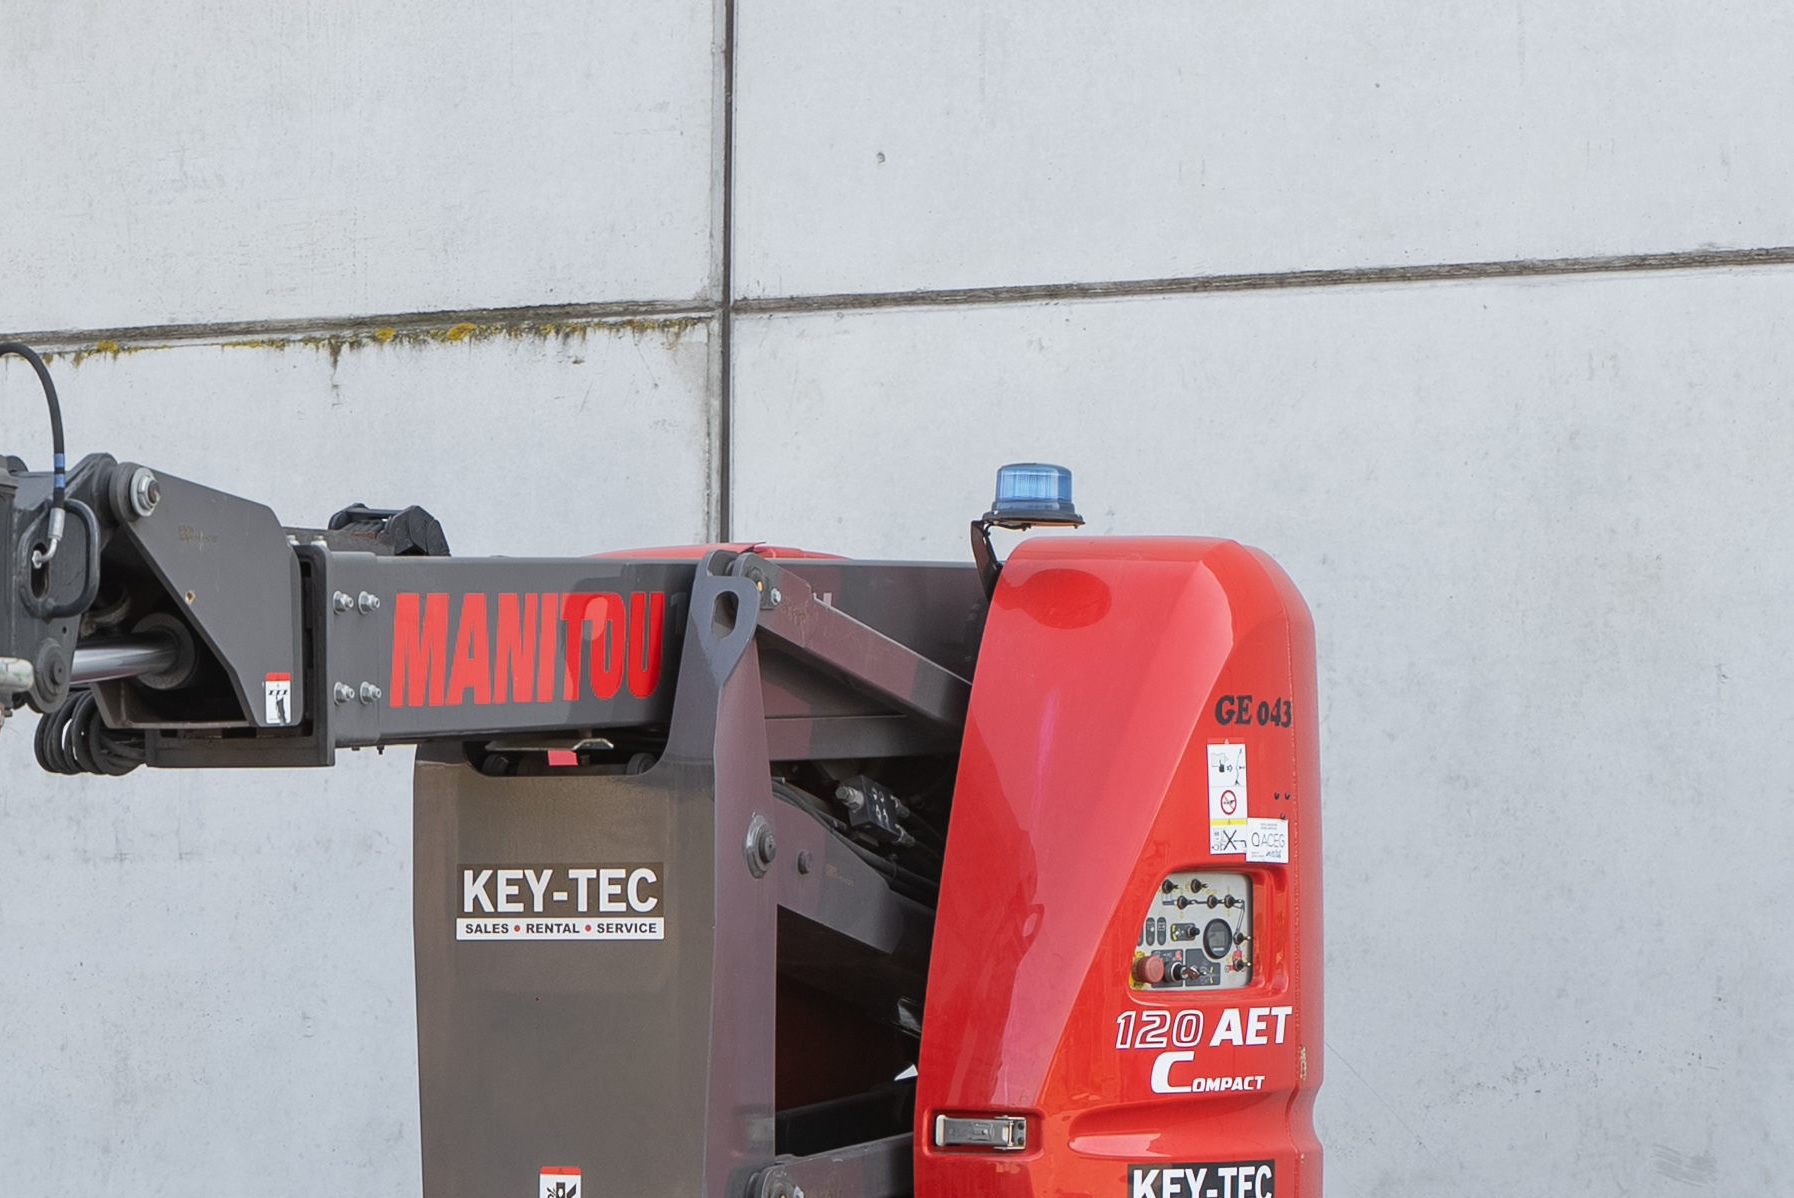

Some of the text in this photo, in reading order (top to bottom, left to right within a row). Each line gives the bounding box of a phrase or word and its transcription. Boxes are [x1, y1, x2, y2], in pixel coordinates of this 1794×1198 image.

[390, 591, 665, 707] MANITOU
[1215, 695, 1292, 728] GE 043
[463, 867, 658, 912] KEY-TEC
[465, 922, 657, 934] SALES RENTAL SERVICE
[1115, 1006, 1293, 1049] 120 AET
[1150, 1051, 1265, 1093] COMPACT
